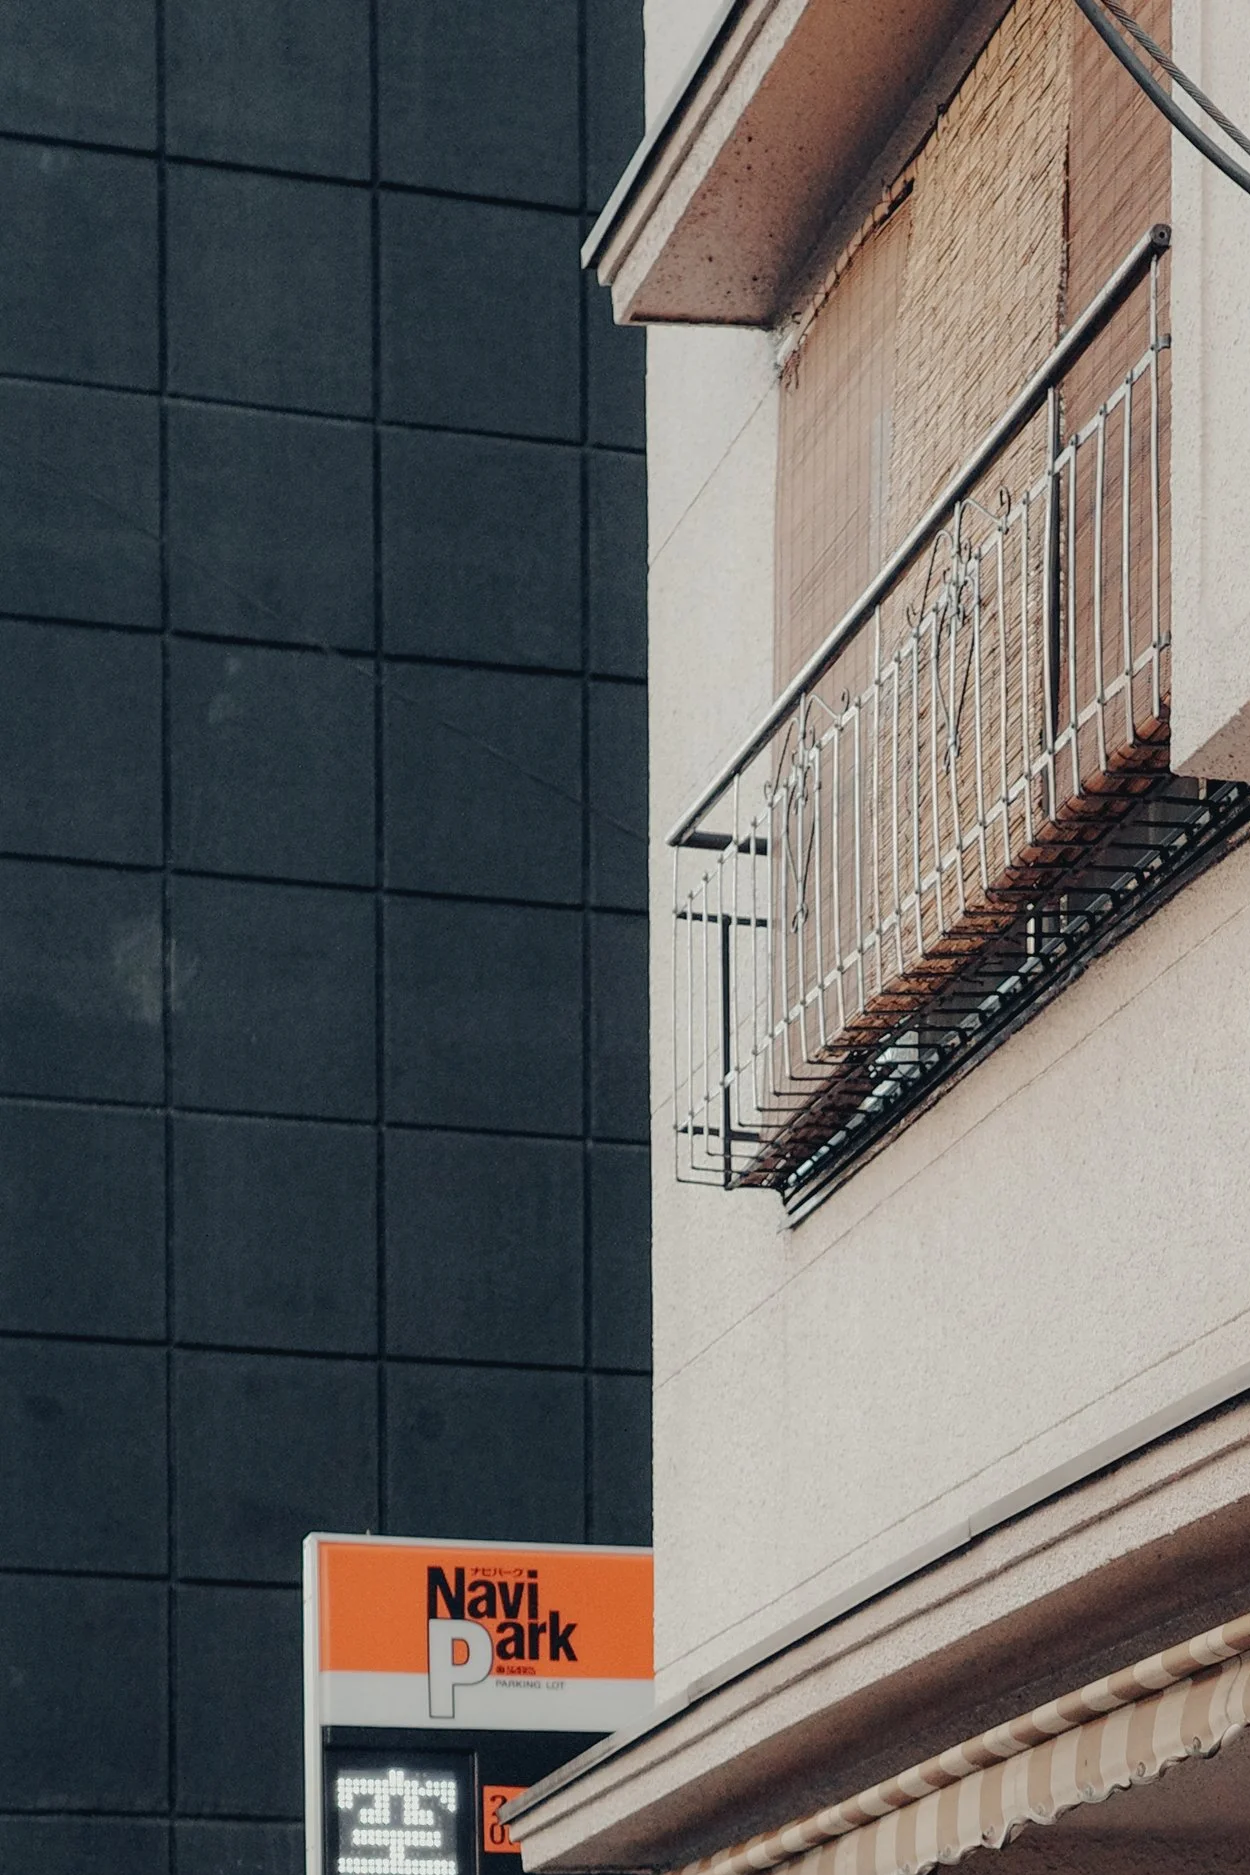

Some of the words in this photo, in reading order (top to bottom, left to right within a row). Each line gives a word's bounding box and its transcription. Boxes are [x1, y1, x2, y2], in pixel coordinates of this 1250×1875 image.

[427, 1566, 539, 1619] Navi
[471, 1567, 524, 1577] ナビパーク
[428, 1610, 578, 1719] Park
[496, 1680, 541, 1689] PARKING
[546, 1681, 565, 1690] LOT
[338, 1769, 457, 1875] 空
